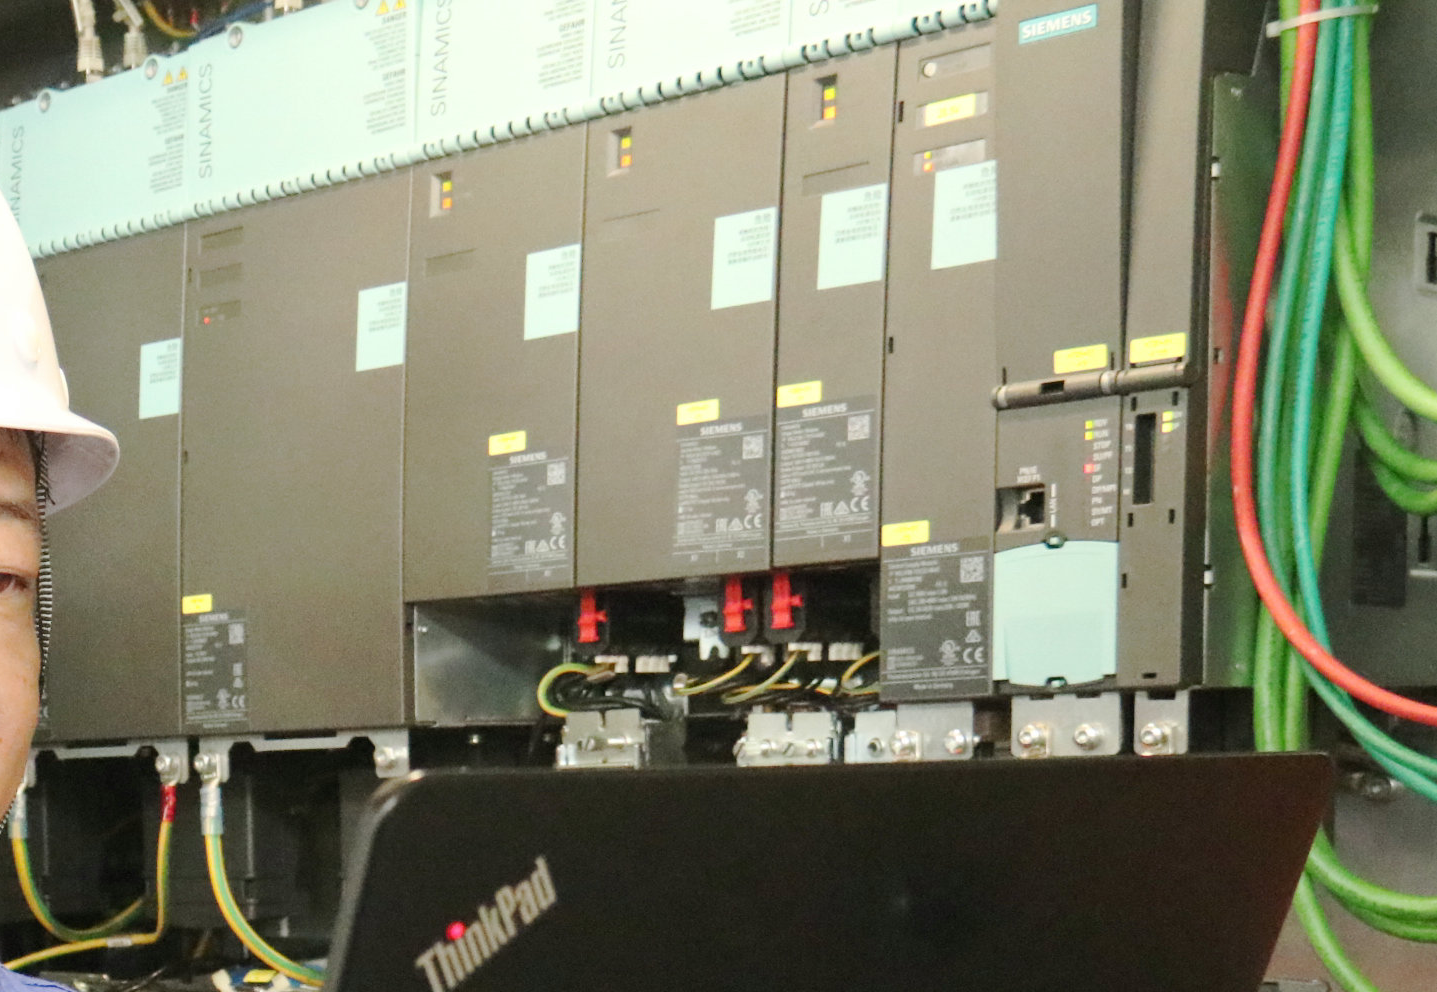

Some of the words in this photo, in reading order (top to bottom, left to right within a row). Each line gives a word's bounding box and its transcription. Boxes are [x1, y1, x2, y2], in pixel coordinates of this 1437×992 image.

[1021, 10, 1092, 39] SIEMENS
[607, 0, 627, 69] SINA
[198, 63, 213, 178] SINAMICS
[802, 403, 847, 417] SIEMENS
[700, 422, 743, 436] SIEMENS
[509, 451, 547, 465] SIEMENS
[850, 496, 869, 512] CE
[744, 513, 762, 529] CE
[549, 535, 566, 550] CE
[910, 543, 959, 557] SIEMENS
[963, 647, 984, 664] CE
